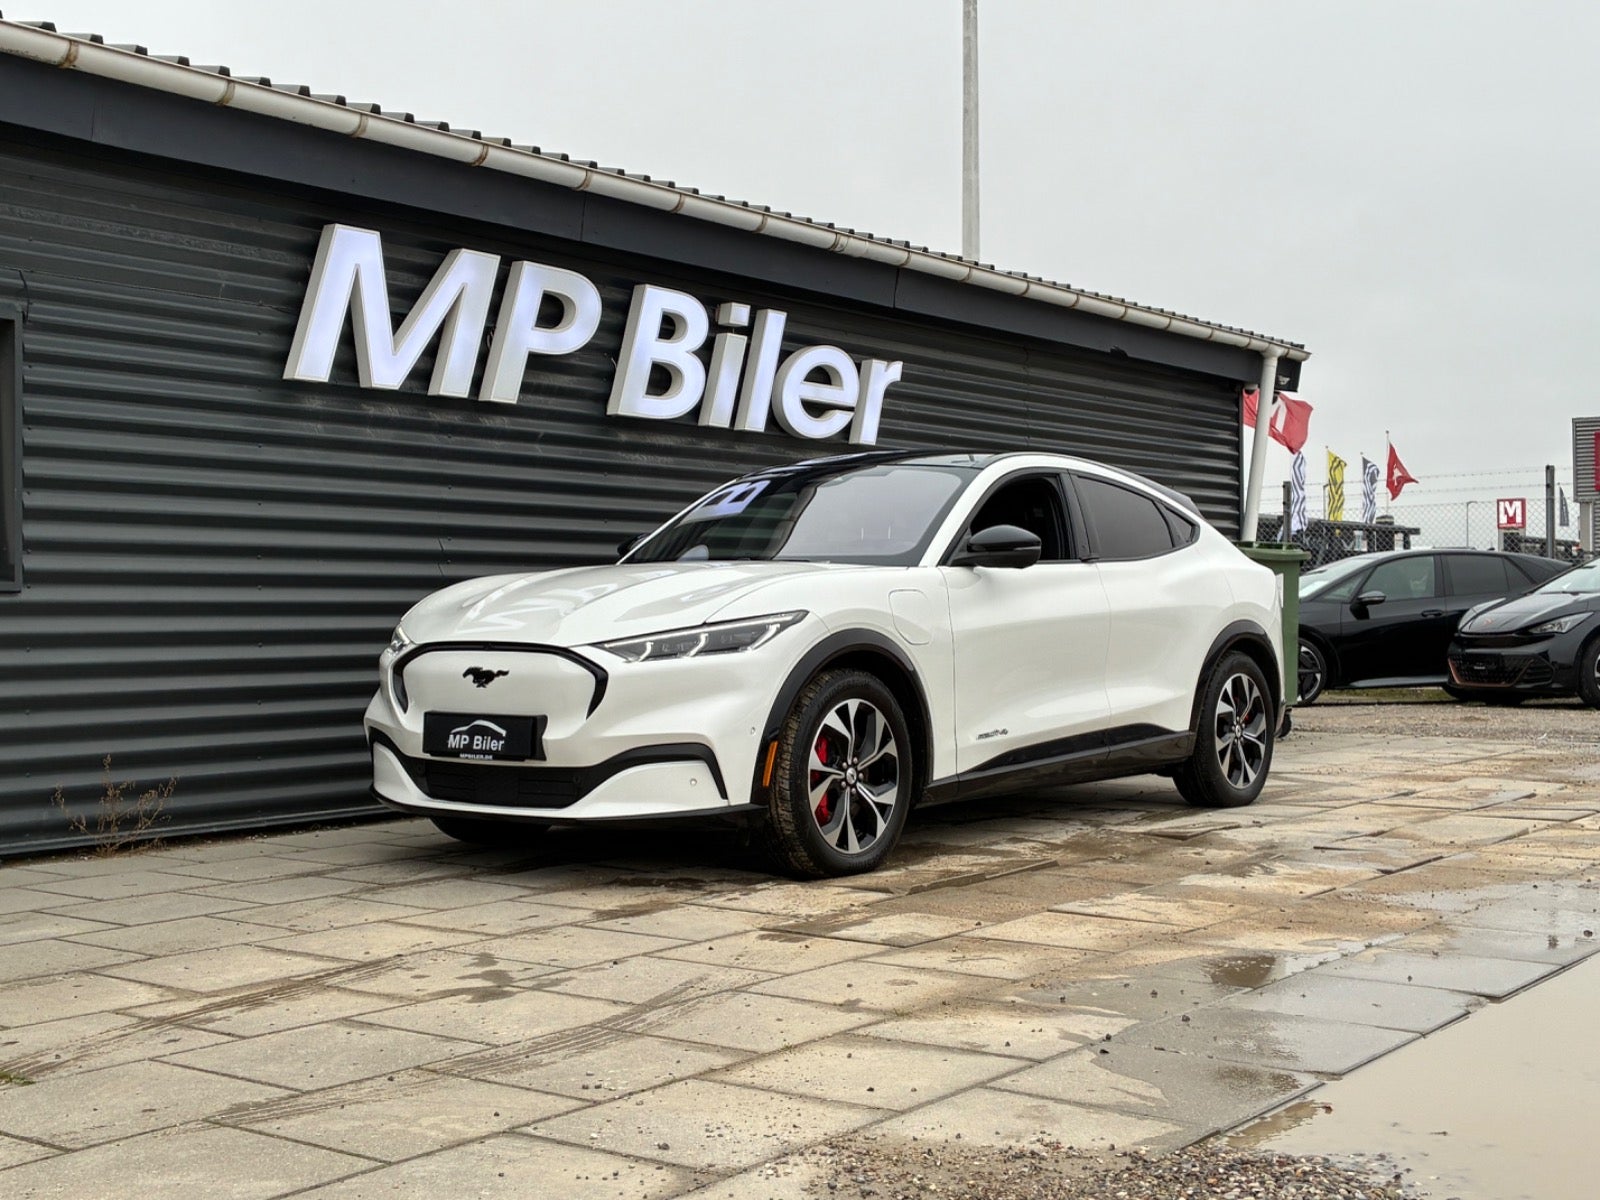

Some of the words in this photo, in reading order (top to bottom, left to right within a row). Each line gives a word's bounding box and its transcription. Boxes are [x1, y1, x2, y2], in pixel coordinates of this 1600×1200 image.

[283, 223, 602, 404] MP
[606, 283, 903, 445] Biler
[448, 734, 470, 749] MP
[473, 735, 505, 751] Biler
